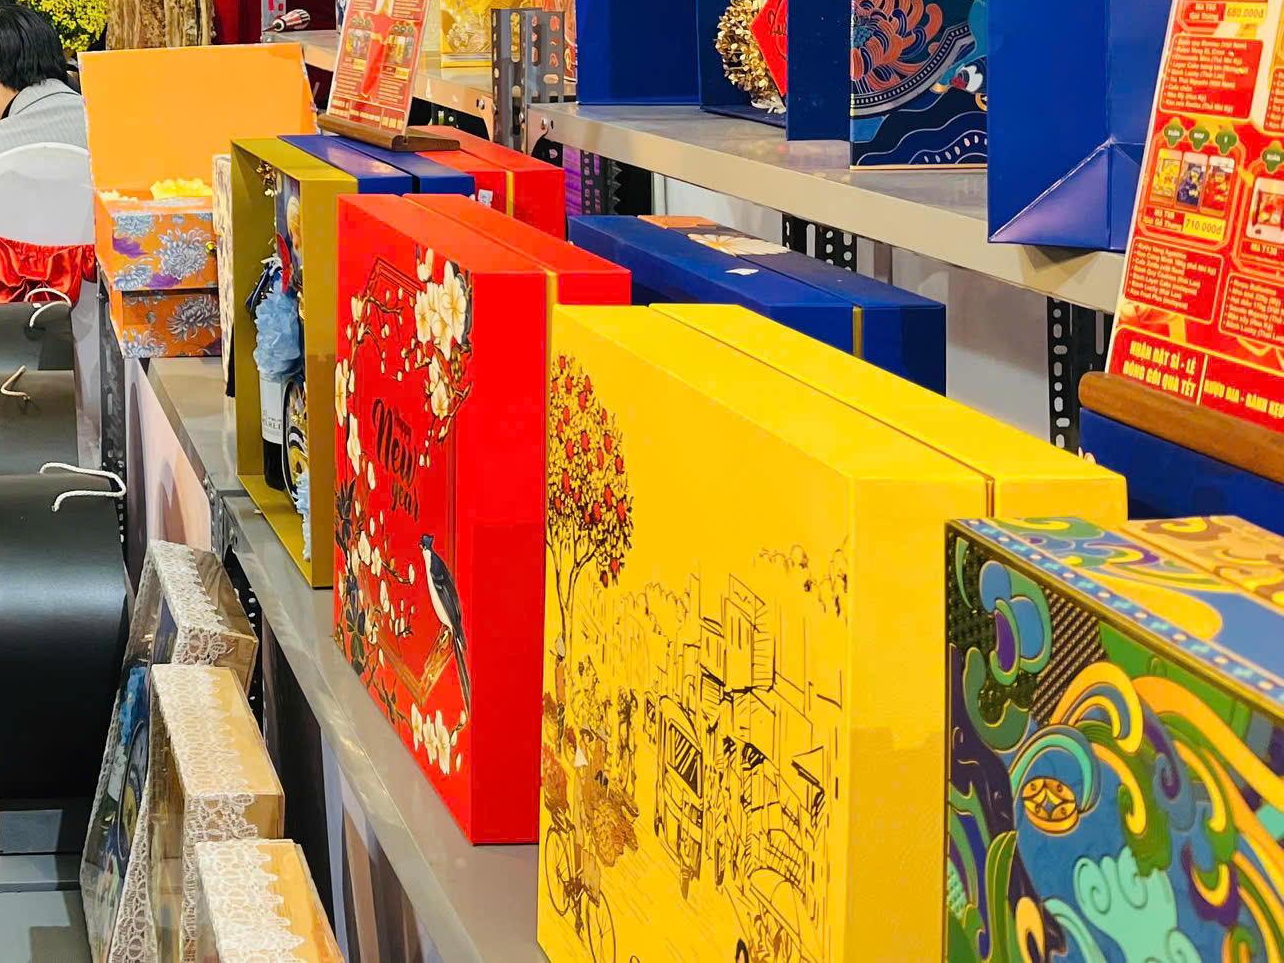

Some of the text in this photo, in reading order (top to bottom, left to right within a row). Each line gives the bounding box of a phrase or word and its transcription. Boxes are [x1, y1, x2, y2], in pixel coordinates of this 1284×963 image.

[1185, 218, 1223, 235] 710.000đ
[1129, 340, 1152, 361] NHẬN
[1152, 347, 1170, 367] ĐẶT
[1122, 360, 1196, 398] ĐÓNG GÓI QUÀ TẾT
[1226, 386, 1240, 403] BIA
[1245, 392, 1268, 413] BÁNH
[372, 398, 418, 487] New
